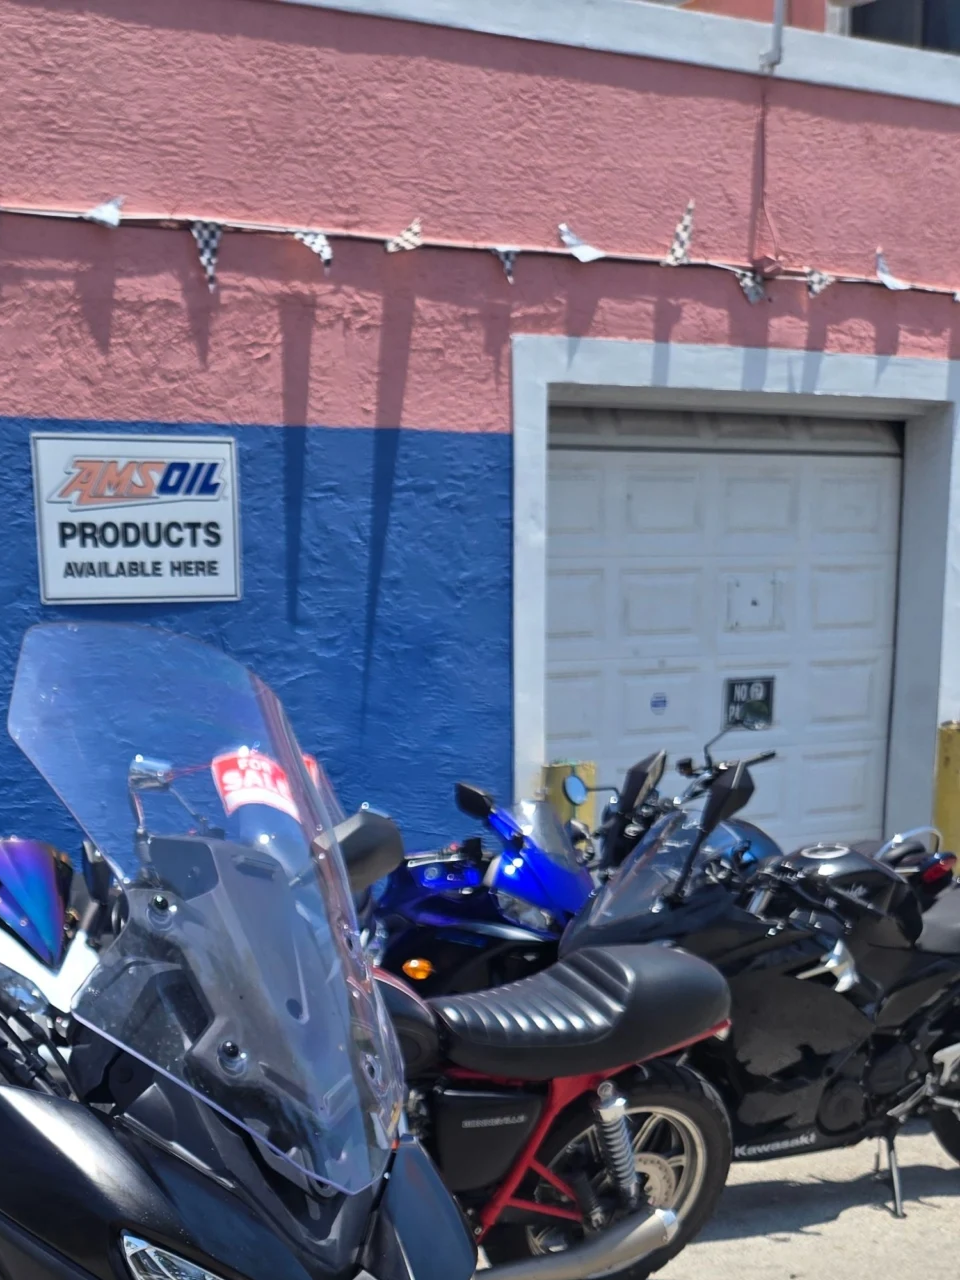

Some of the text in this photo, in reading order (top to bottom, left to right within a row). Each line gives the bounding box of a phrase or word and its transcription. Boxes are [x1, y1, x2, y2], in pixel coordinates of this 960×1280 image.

[57, 459, 222, 505] AMSOIL
[58, 520, 222, 549] PRODUCTS
[63, 560, 220, 579] AVAILABLE HERE
[734, 1131, 817, 1157] Kawasaki
